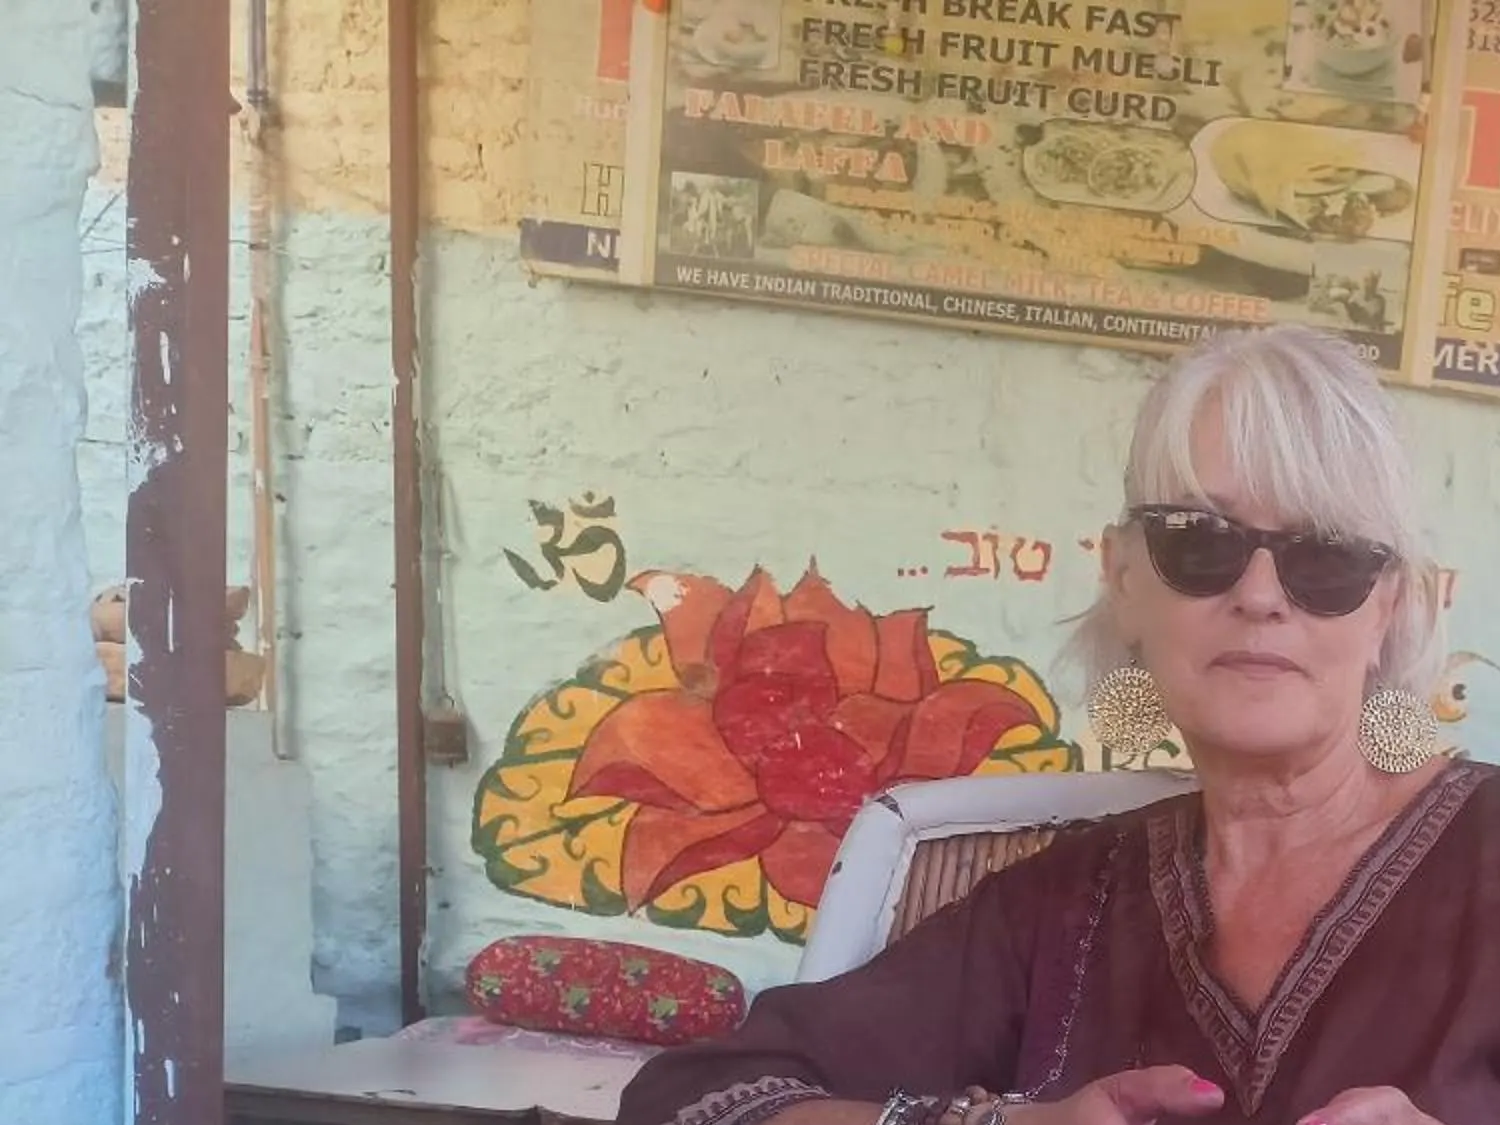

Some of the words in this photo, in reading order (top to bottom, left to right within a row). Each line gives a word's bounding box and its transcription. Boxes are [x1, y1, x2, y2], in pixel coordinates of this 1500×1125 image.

[802, 17, 926, 56] FRESH
[939, 31, 1061, 69] FRUIT
[1085, 5, 1182, 40] FAST
[799, 59, 922, 95] FRESH
[937, 73, 1057, 110] FRUIT
[1067, 87, 1178, 122] CURD
[676, 266, 701, 284] WE
[707, 268, 750, 289] HAVE
[754, 274, 816, 296] INDIAN
[821, 282, 938, 314] TRADITIONAL,
[943, 296, 1021, 322] CHINESE,
[1024, 305, 1098, 331] ITALIAN,
